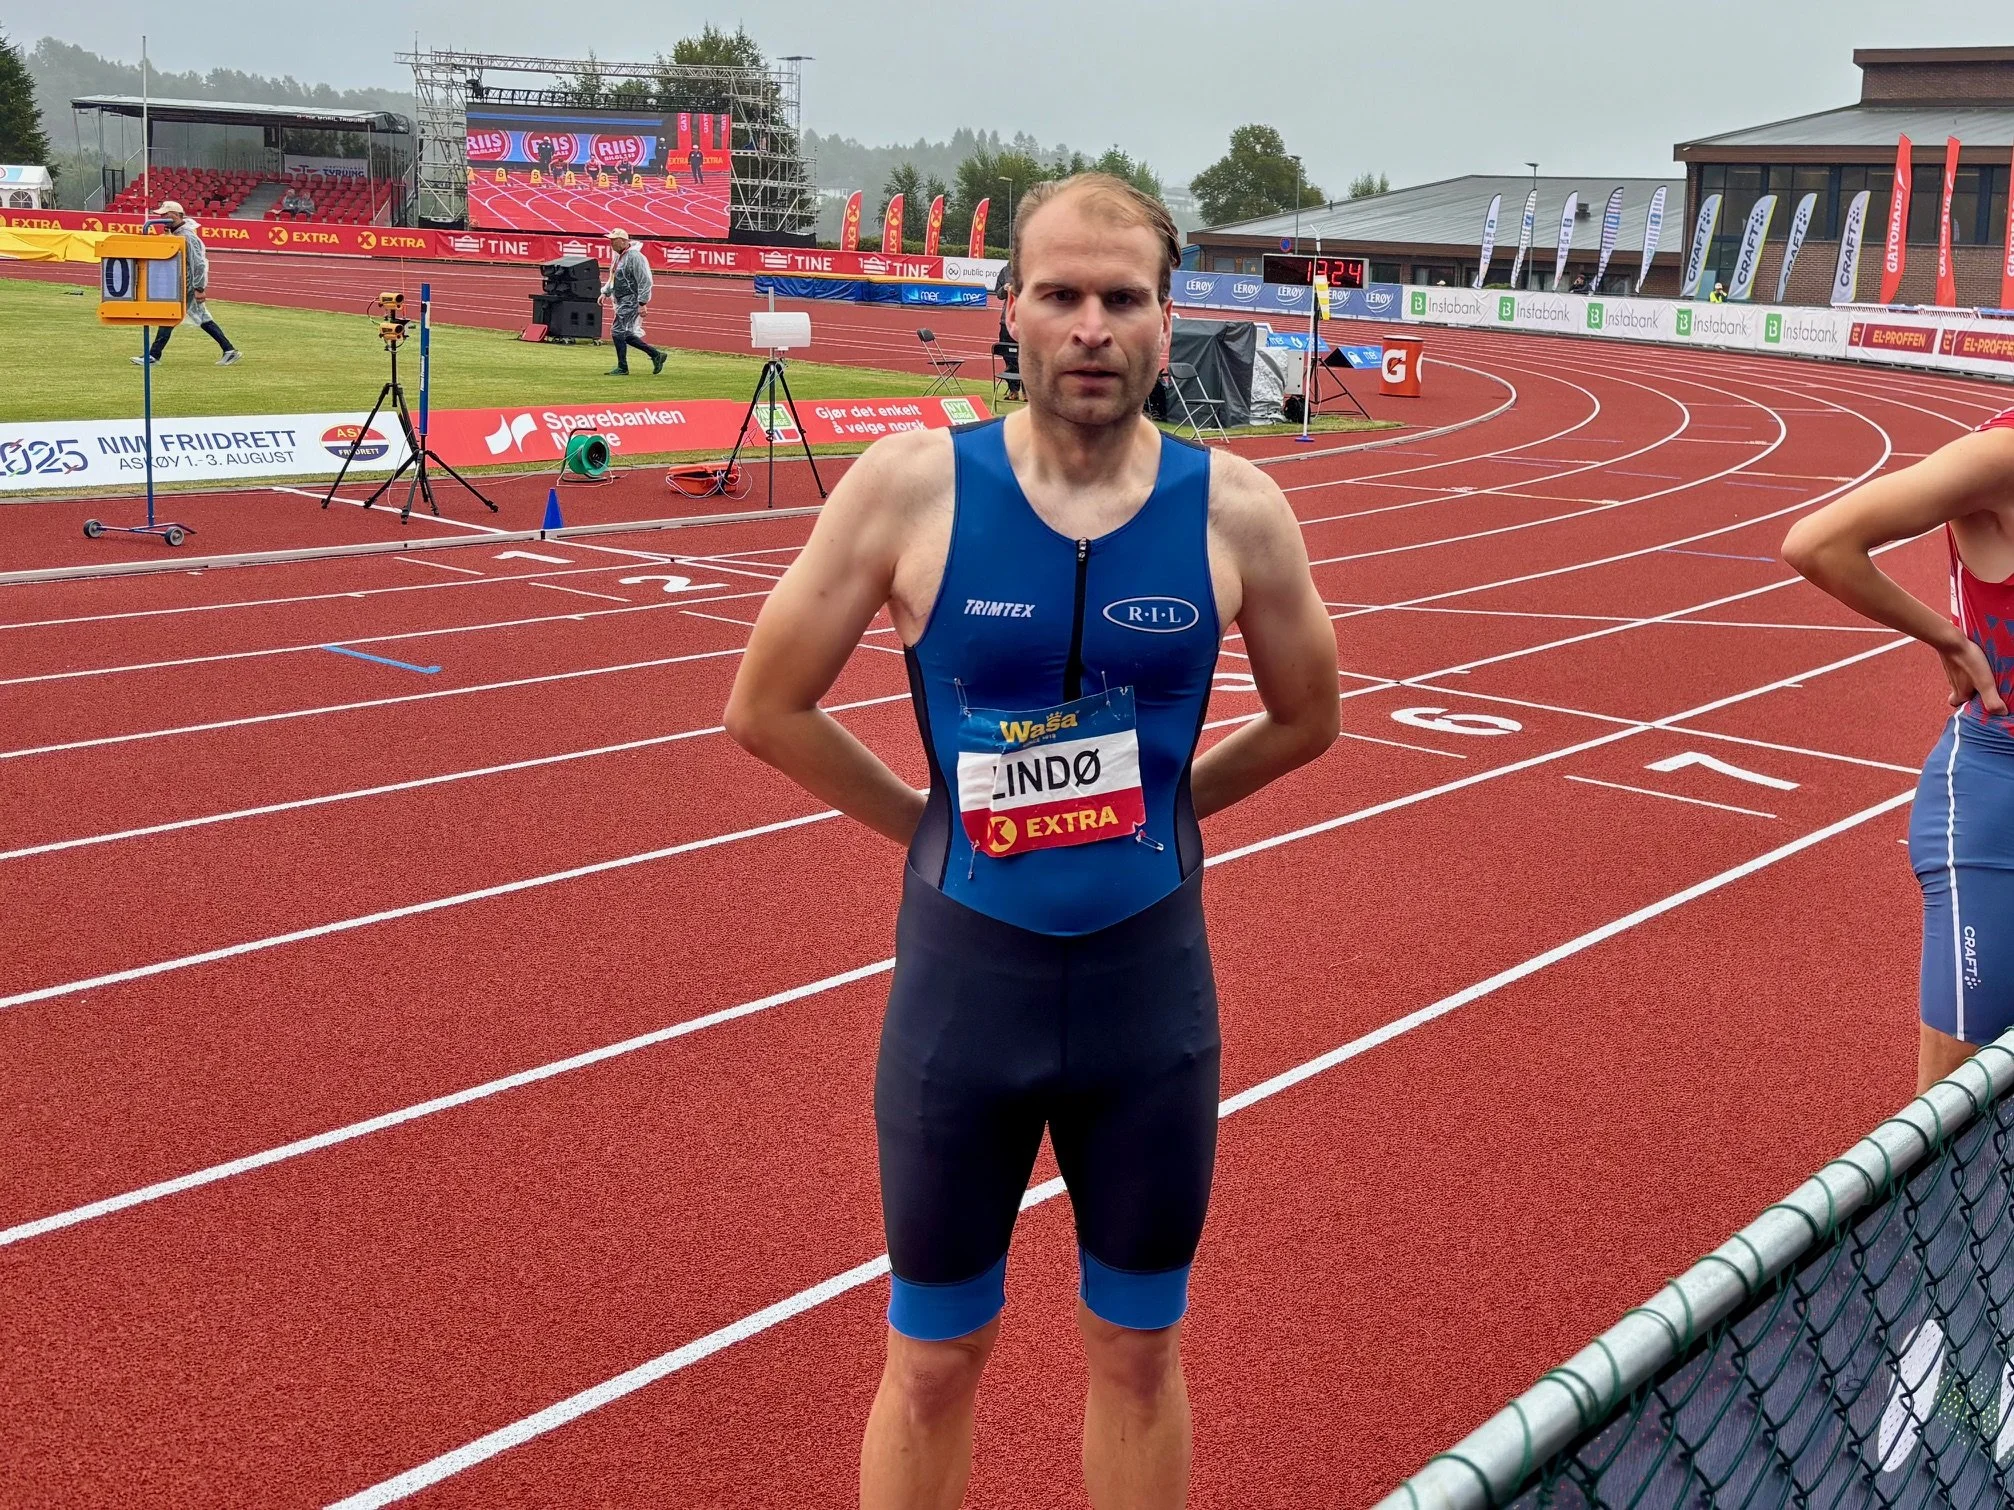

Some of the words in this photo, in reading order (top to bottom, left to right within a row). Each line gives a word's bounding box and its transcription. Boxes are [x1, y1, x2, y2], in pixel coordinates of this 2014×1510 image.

[467, 133, 502, 150] RIIS
[598, 139, 636, 156] RIIS
[567, 173, 572, 183] 4
[12, 218, 62, 230] EXTRA
[1886, 190, 1903, 273] GATORADE
[202, 227, 250, 240] EXTRA
[292, 232, 340, 244] EXTRA
[381, 236, 426, 249] EXTRA
[488, 240, 529, 256] TINE
[698, 252, 736, 266] TINE
[1688, 223, 1707, 282] CRAFT
[1738, 225, 1759, 286] CRAFT
[1840, 224, 1857, 287] CRAFT
[795, 256, 832, 271] TINE
[893, 263, 930, 278] TINE
[105, 257, 130, 298] 0
[986, 270, 1000, 278] pro
[1186, 279, 1214, 291] LERØY
[1233, 282, 1260, 294] LERØY
[1278, 285, 1305, 298] LERØY
[1329, 289, 1350, 302] ERØY
[1366, 292, 1393, 304] LERØY
[1428, 296, 1481, 315] Instabank
[1517, 301, 1570, 322] Instabank
[1605, 308, 1658, 329] Instabank
[1693, 314, 1747, 336] Instabank
[1783, 321, 1837, 344] Instabank
[1381, 349, 1407, 383] G
[542, 408, 686, 431] Sparebanken
[815, 406, 847, 421] Gjør
[850, 405, 875, 418] det
[878, 404, 921, 417] enkelt
[833, 420, 844, 435] å
[846, 422, 886, 435] velge
[888, 419, 927, 432] norsk
[97, 435, 150, 454] NM
[160, 430, 296, 452] FRIIDRETT
[0, 438, 88, 477] 025
[226, 451, 295, 465] AUGUST
[618, 575, 731, 593] 2
[963, 599, 1036, 618] TRIMTEX
[1000, 712, 1078, 743] Wasa
[1390, 707, 1523, 737] 6
[1026, 805, 1119, 838] EXTRA
[1964, 925, 1978, 977] CRAFT
